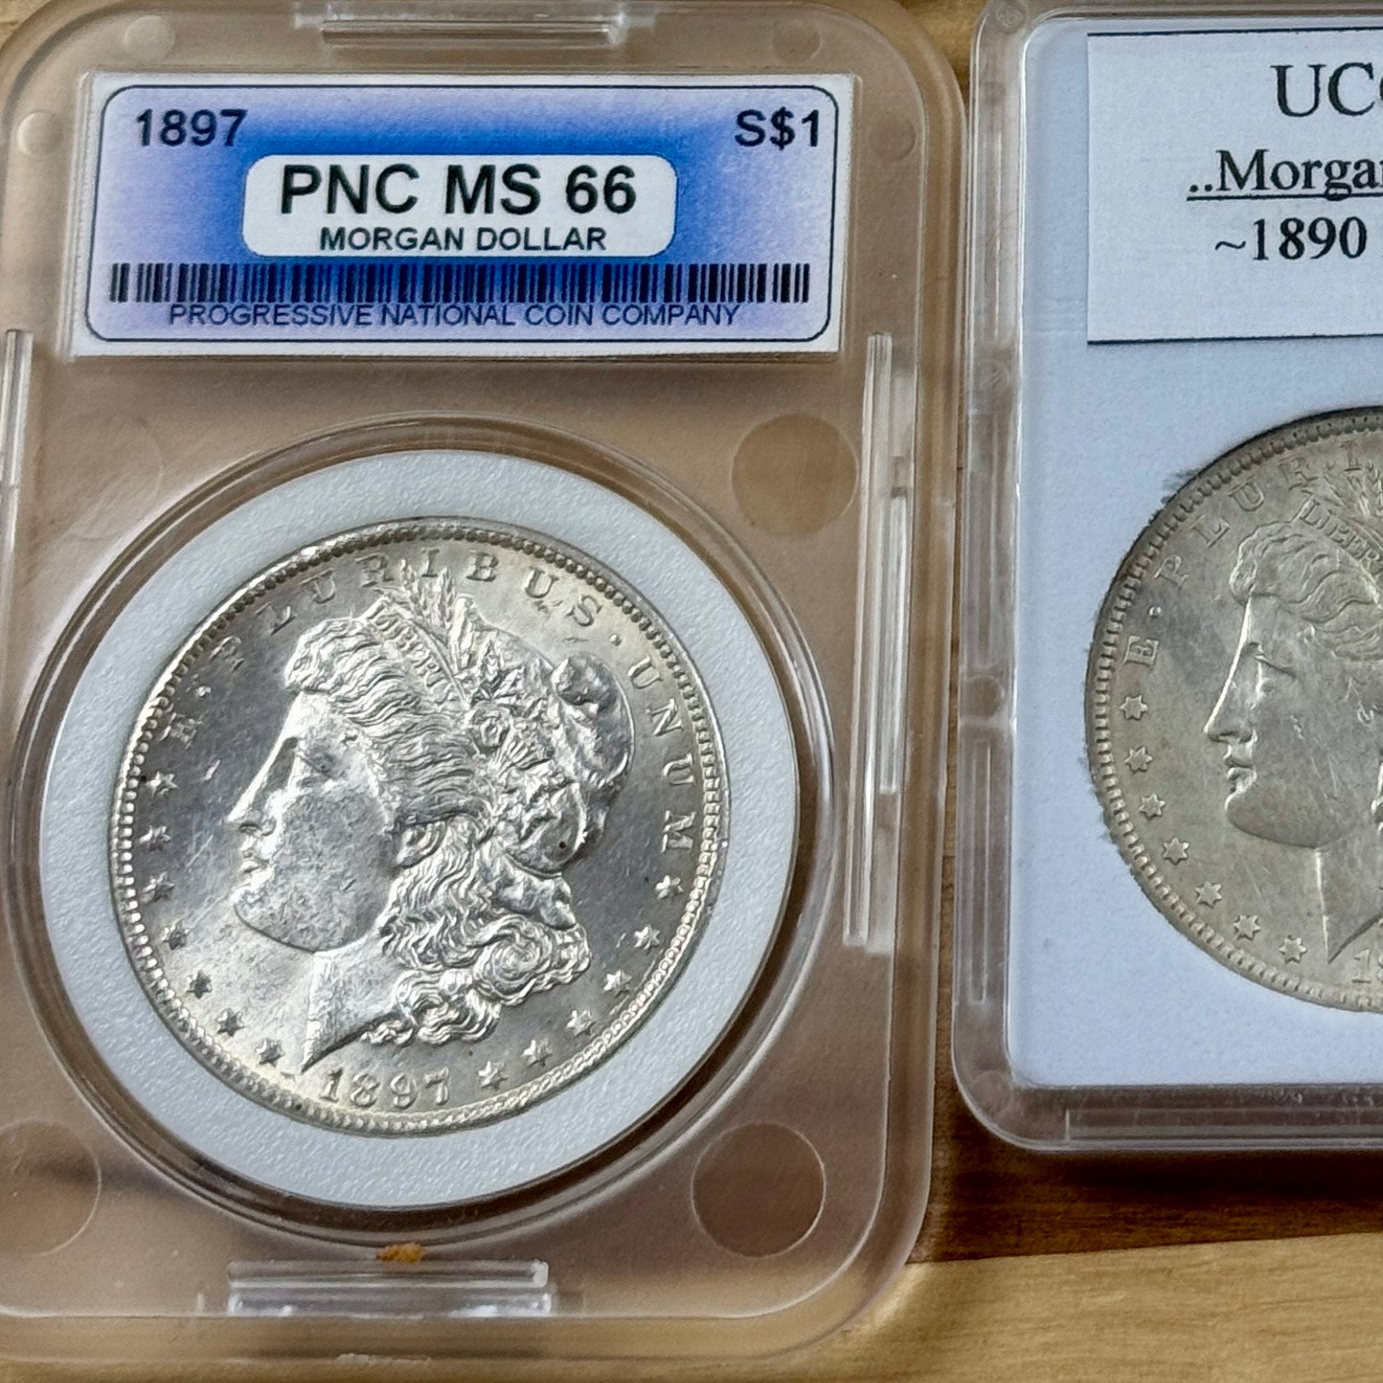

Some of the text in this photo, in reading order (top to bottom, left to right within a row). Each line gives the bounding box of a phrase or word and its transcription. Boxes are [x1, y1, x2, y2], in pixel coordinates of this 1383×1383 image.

[135, 105, 822, 150] 1897 S$1
[279, 163, 638, 216] PNC MS 66
[319, 225, 608, 253] MORGAN DOLLAR
[169, 302, 741, 328] PROGRESSIVE NATIONAL COIN COMPANY
[626, 655, 694, 855] UNUM
[319, 1065, 452, 1108] 1897
